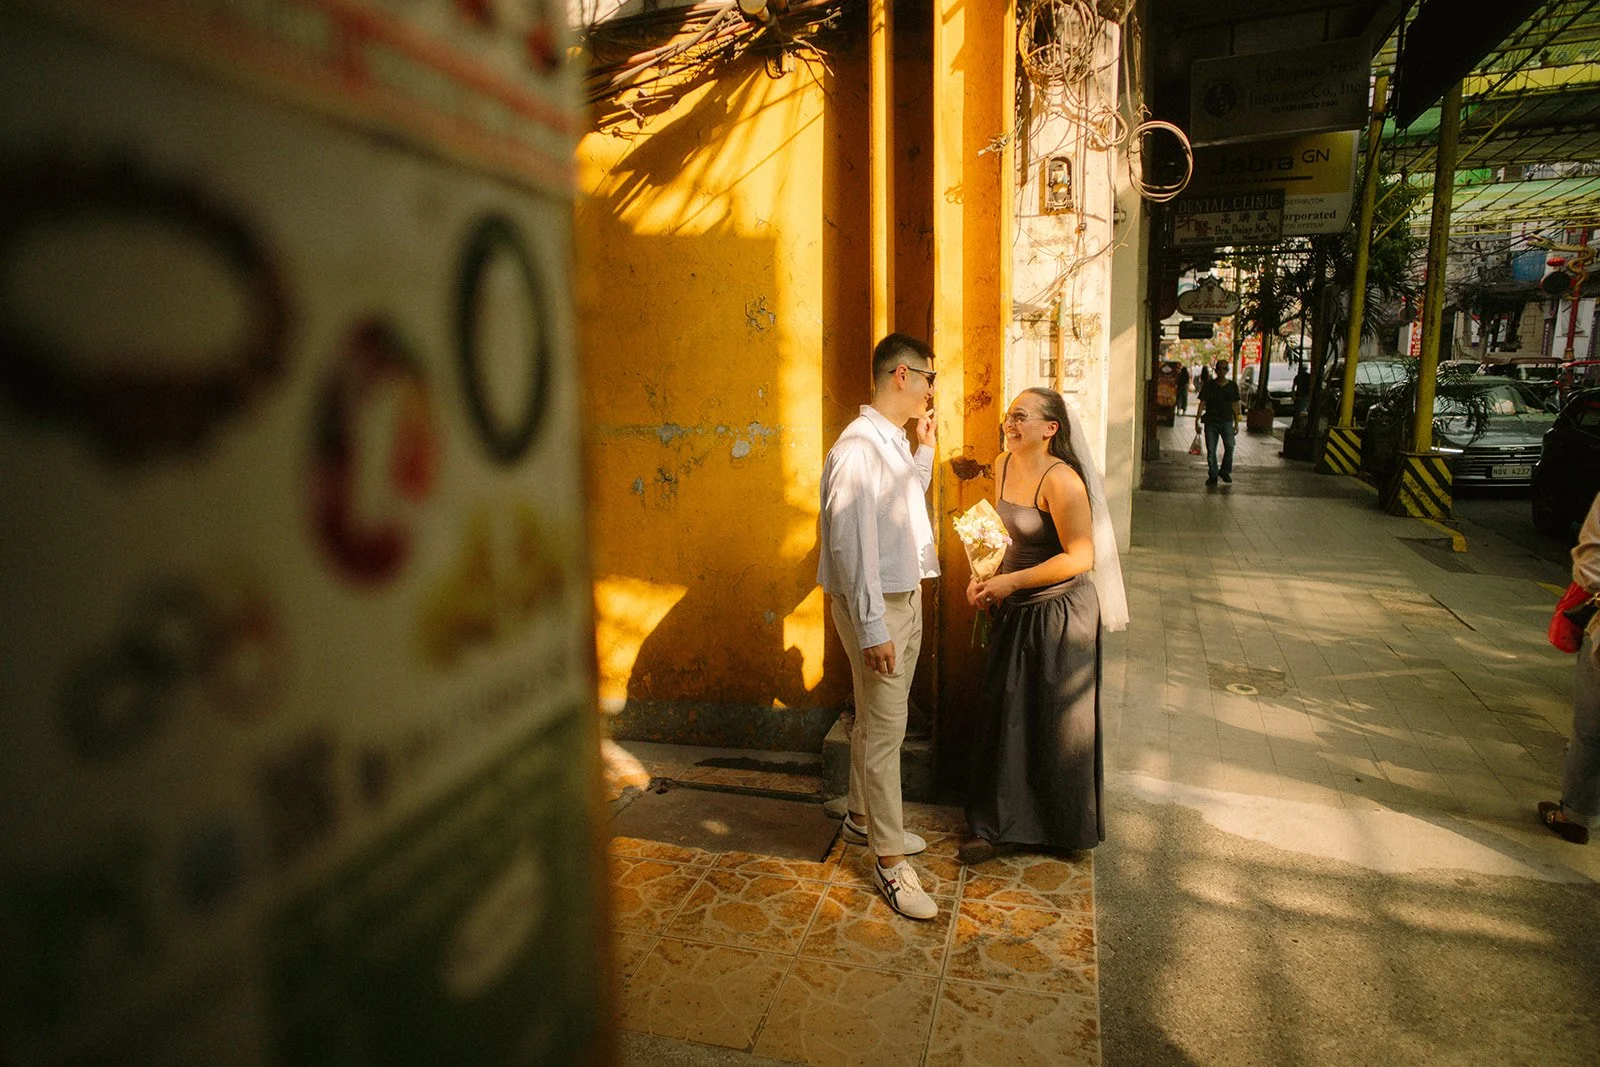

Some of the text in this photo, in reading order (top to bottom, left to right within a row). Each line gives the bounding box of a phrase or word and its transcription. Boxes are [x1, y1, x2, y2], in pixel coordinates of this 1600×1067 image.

[1302, 148, 1330, 164] GN
[1178, 194, 1279, 213] DENTAL CLINIC
